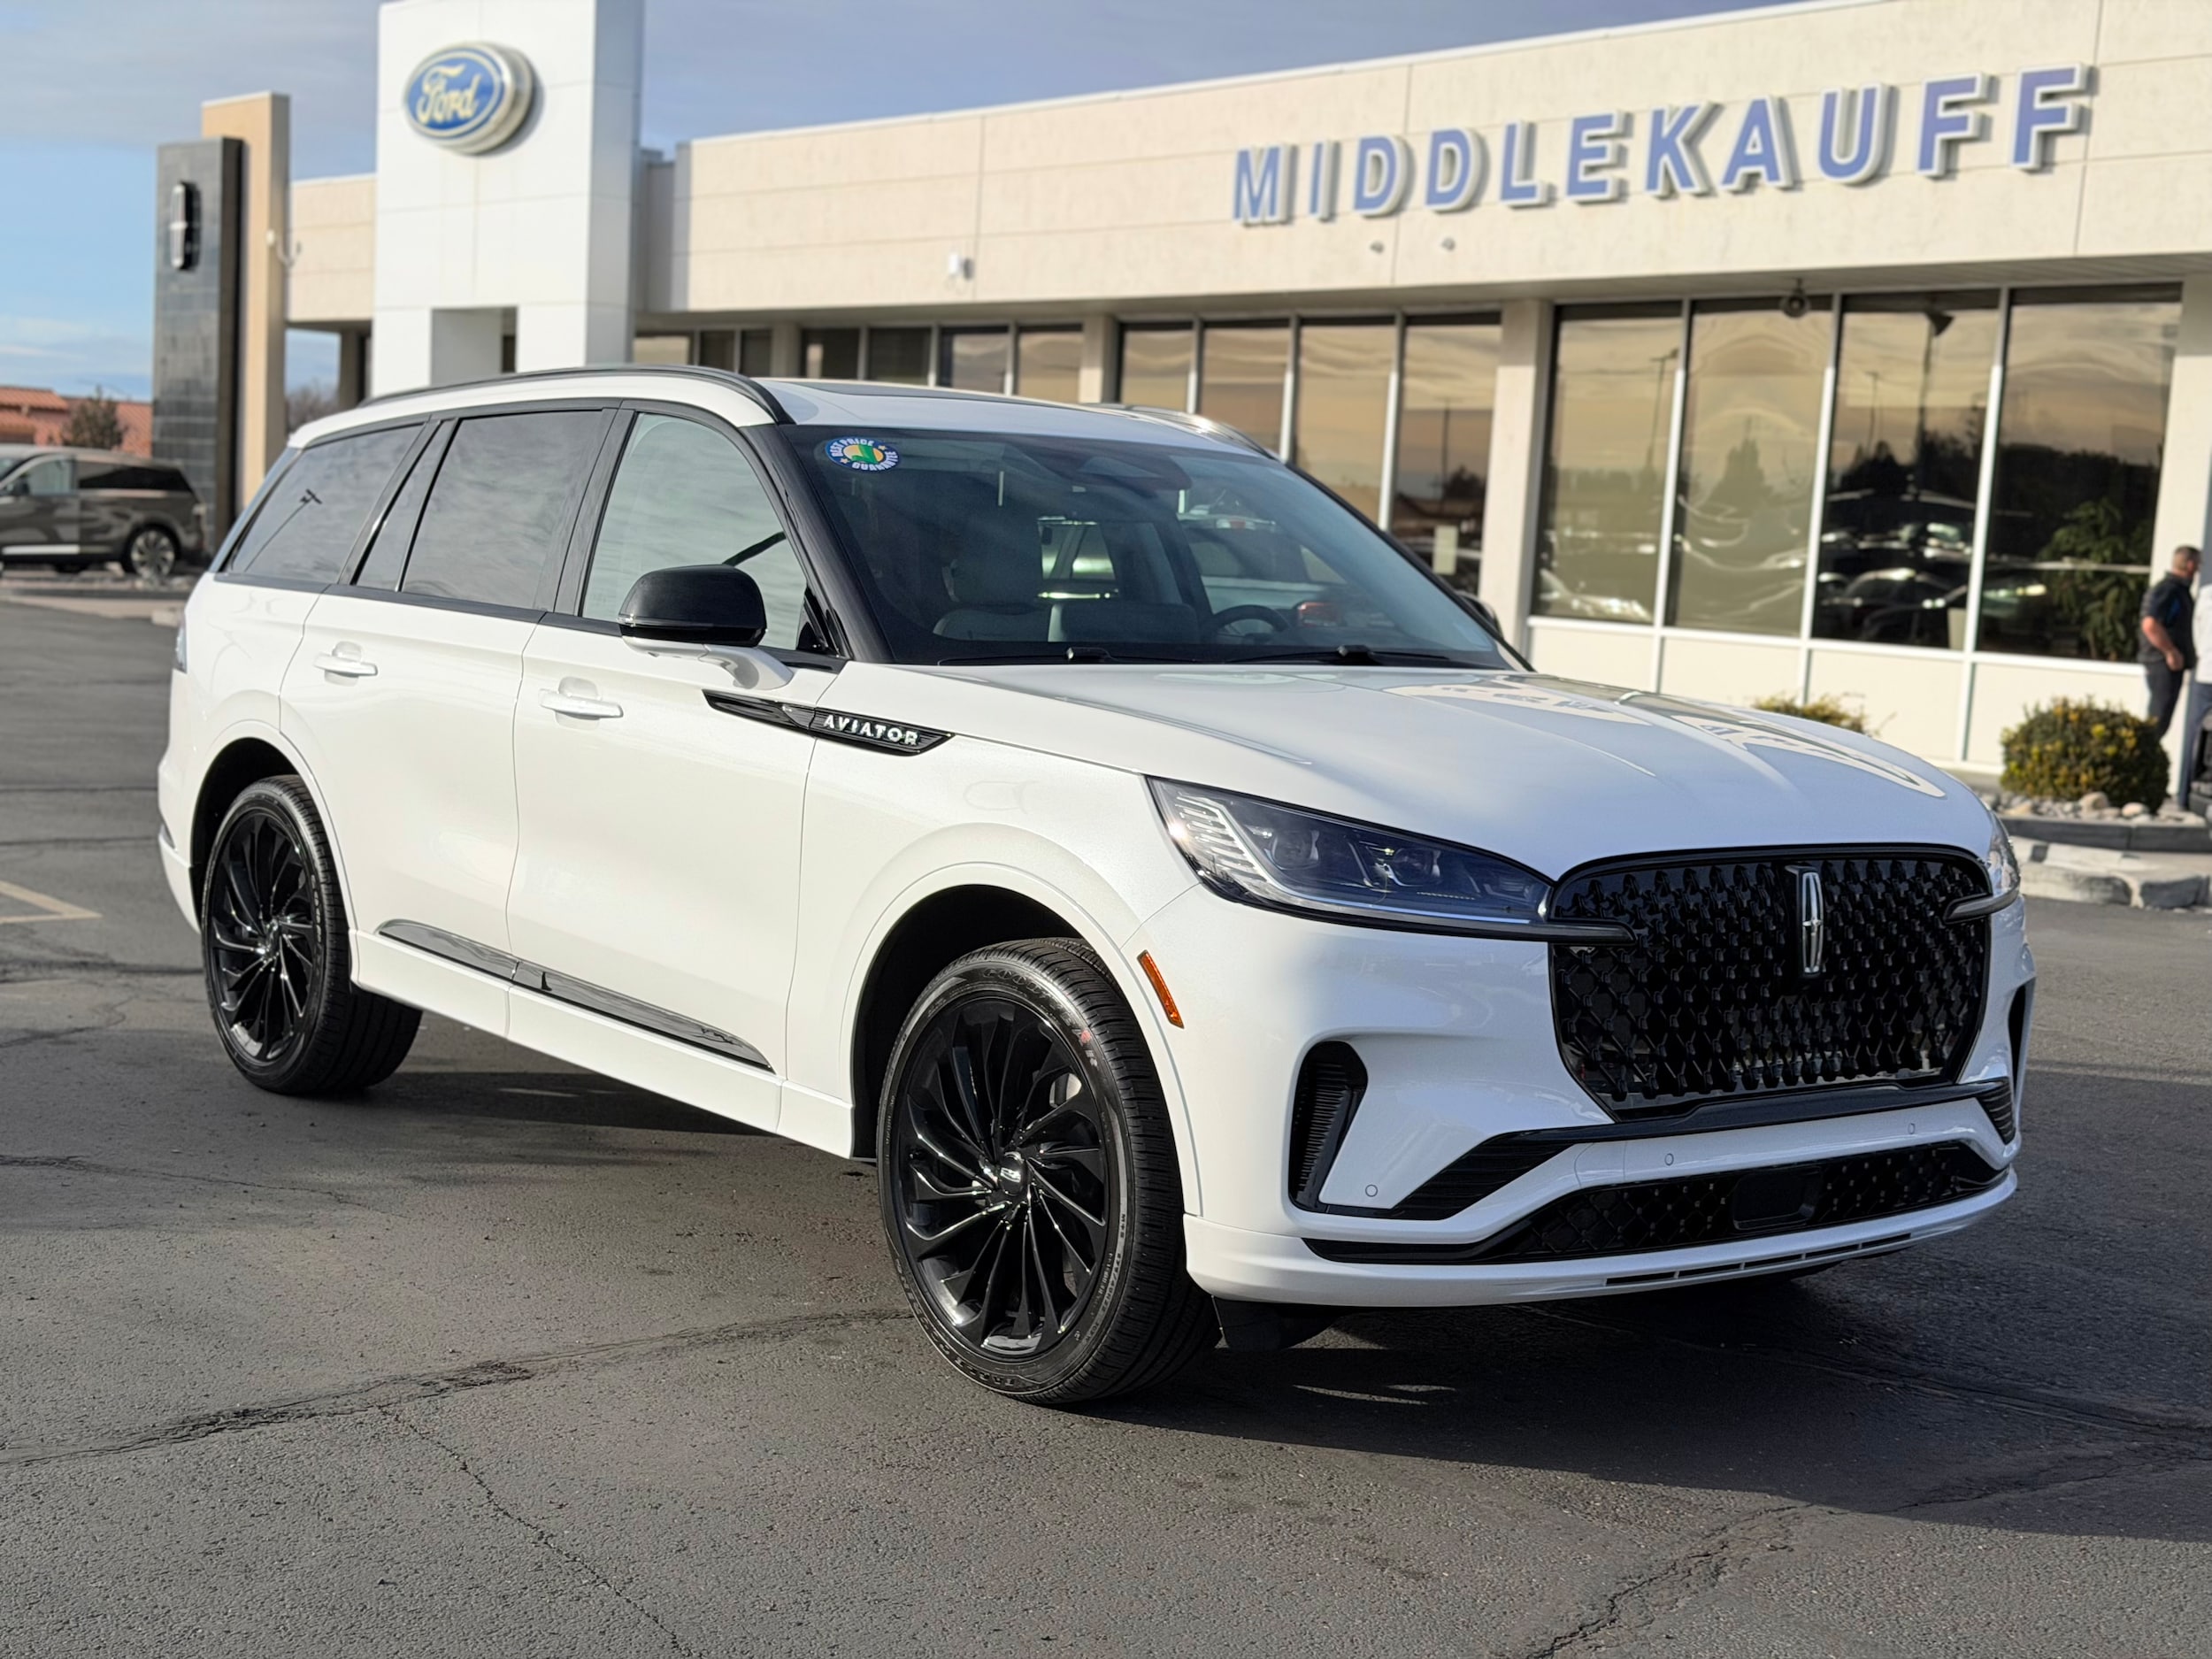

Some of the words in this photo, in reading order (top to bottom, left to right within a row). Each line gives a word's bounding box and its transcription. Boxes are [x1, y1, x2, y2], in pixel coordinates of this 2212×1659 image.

[416, 63, 482, 124] Ford
[1232, 63, 2097, 227] MIDDLEKAUFF
[830, 442, 845, 457] BEST
[839, 437, 875, 447] PRICE
[852, 451, 898, 471] GUARANTEE
[824, 715, 918, 745] AVIATOR
